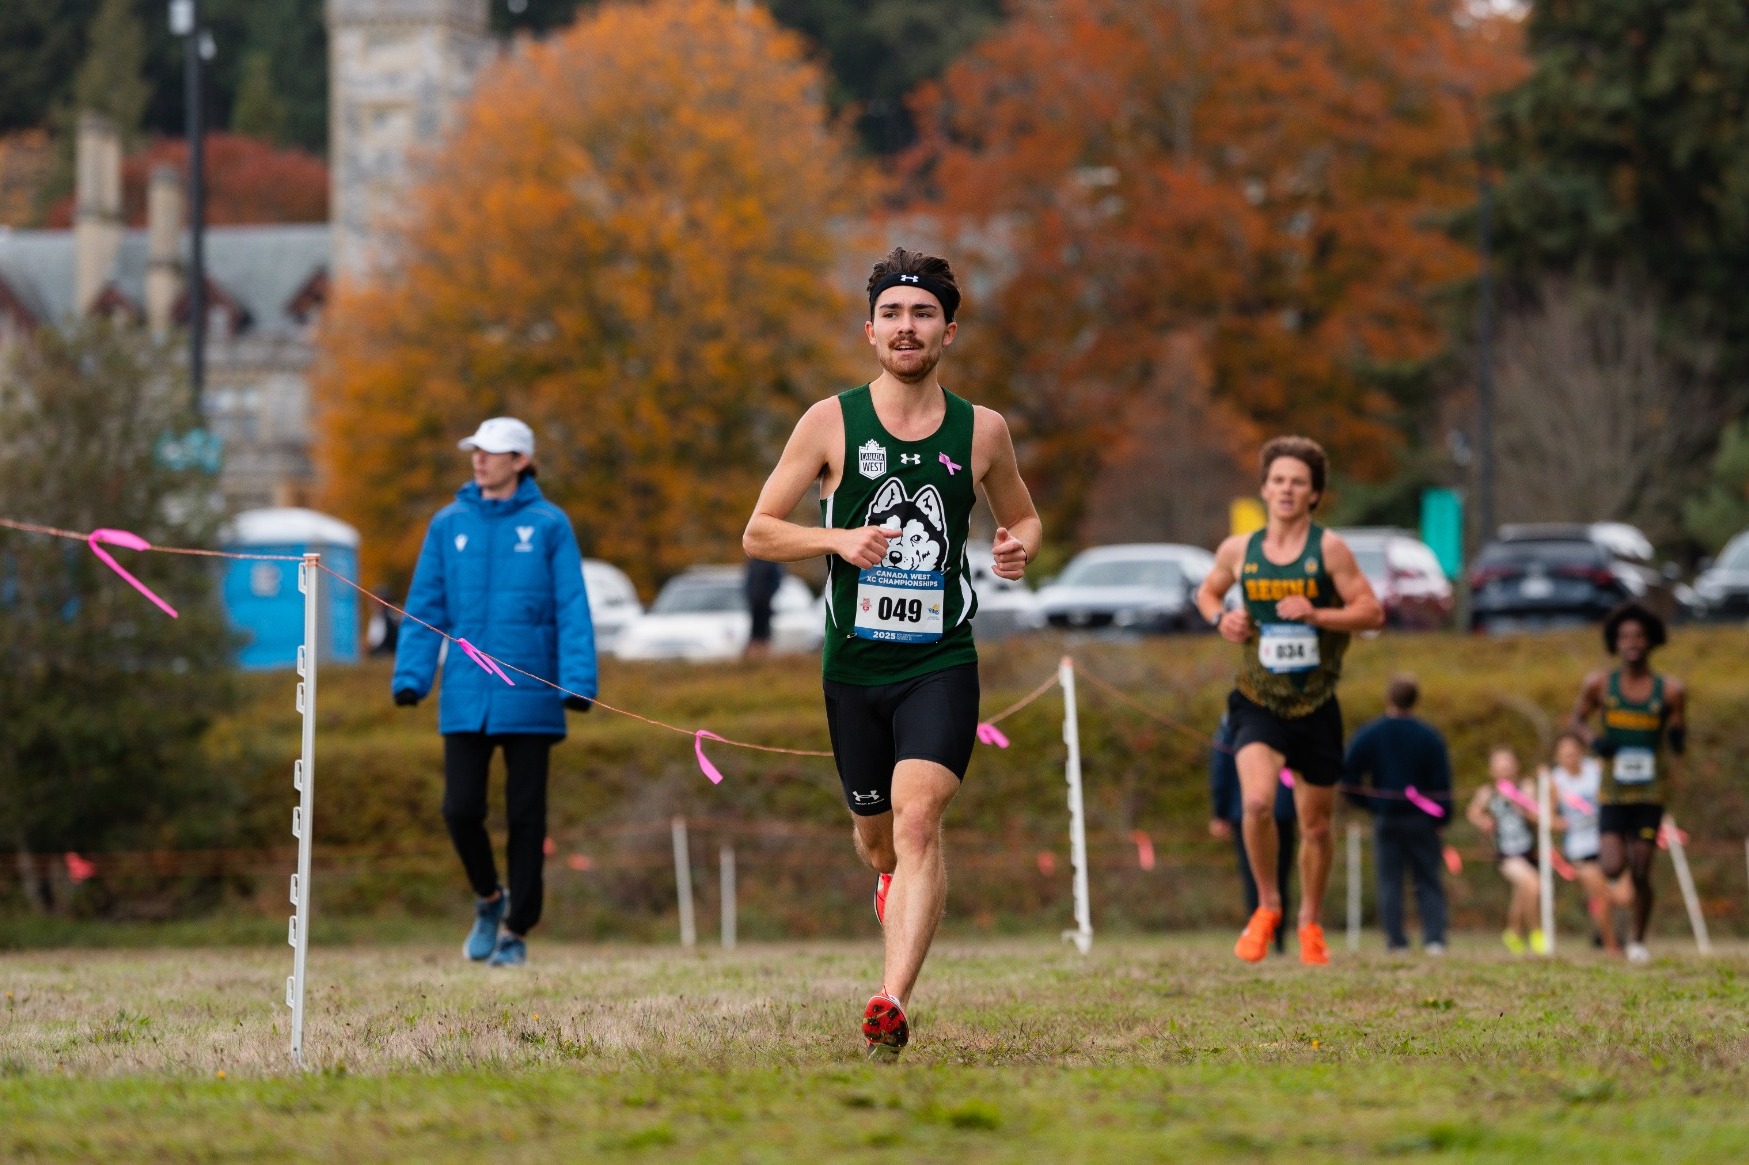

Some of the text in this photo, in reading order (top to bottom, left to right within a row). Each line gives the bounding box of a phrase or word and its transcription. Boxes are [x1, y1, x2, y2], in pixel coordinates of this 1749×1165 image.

[861, 453, 884, 461] CANADA
[862, 462, 883, 472] WEST
[876, 570, 908, 580] CANADA
[866, 575, 938, 587] XC CHAMPIONSHIPS
[878, 596, 922, 623] 049
[872, 630, 896, 640] 2025
